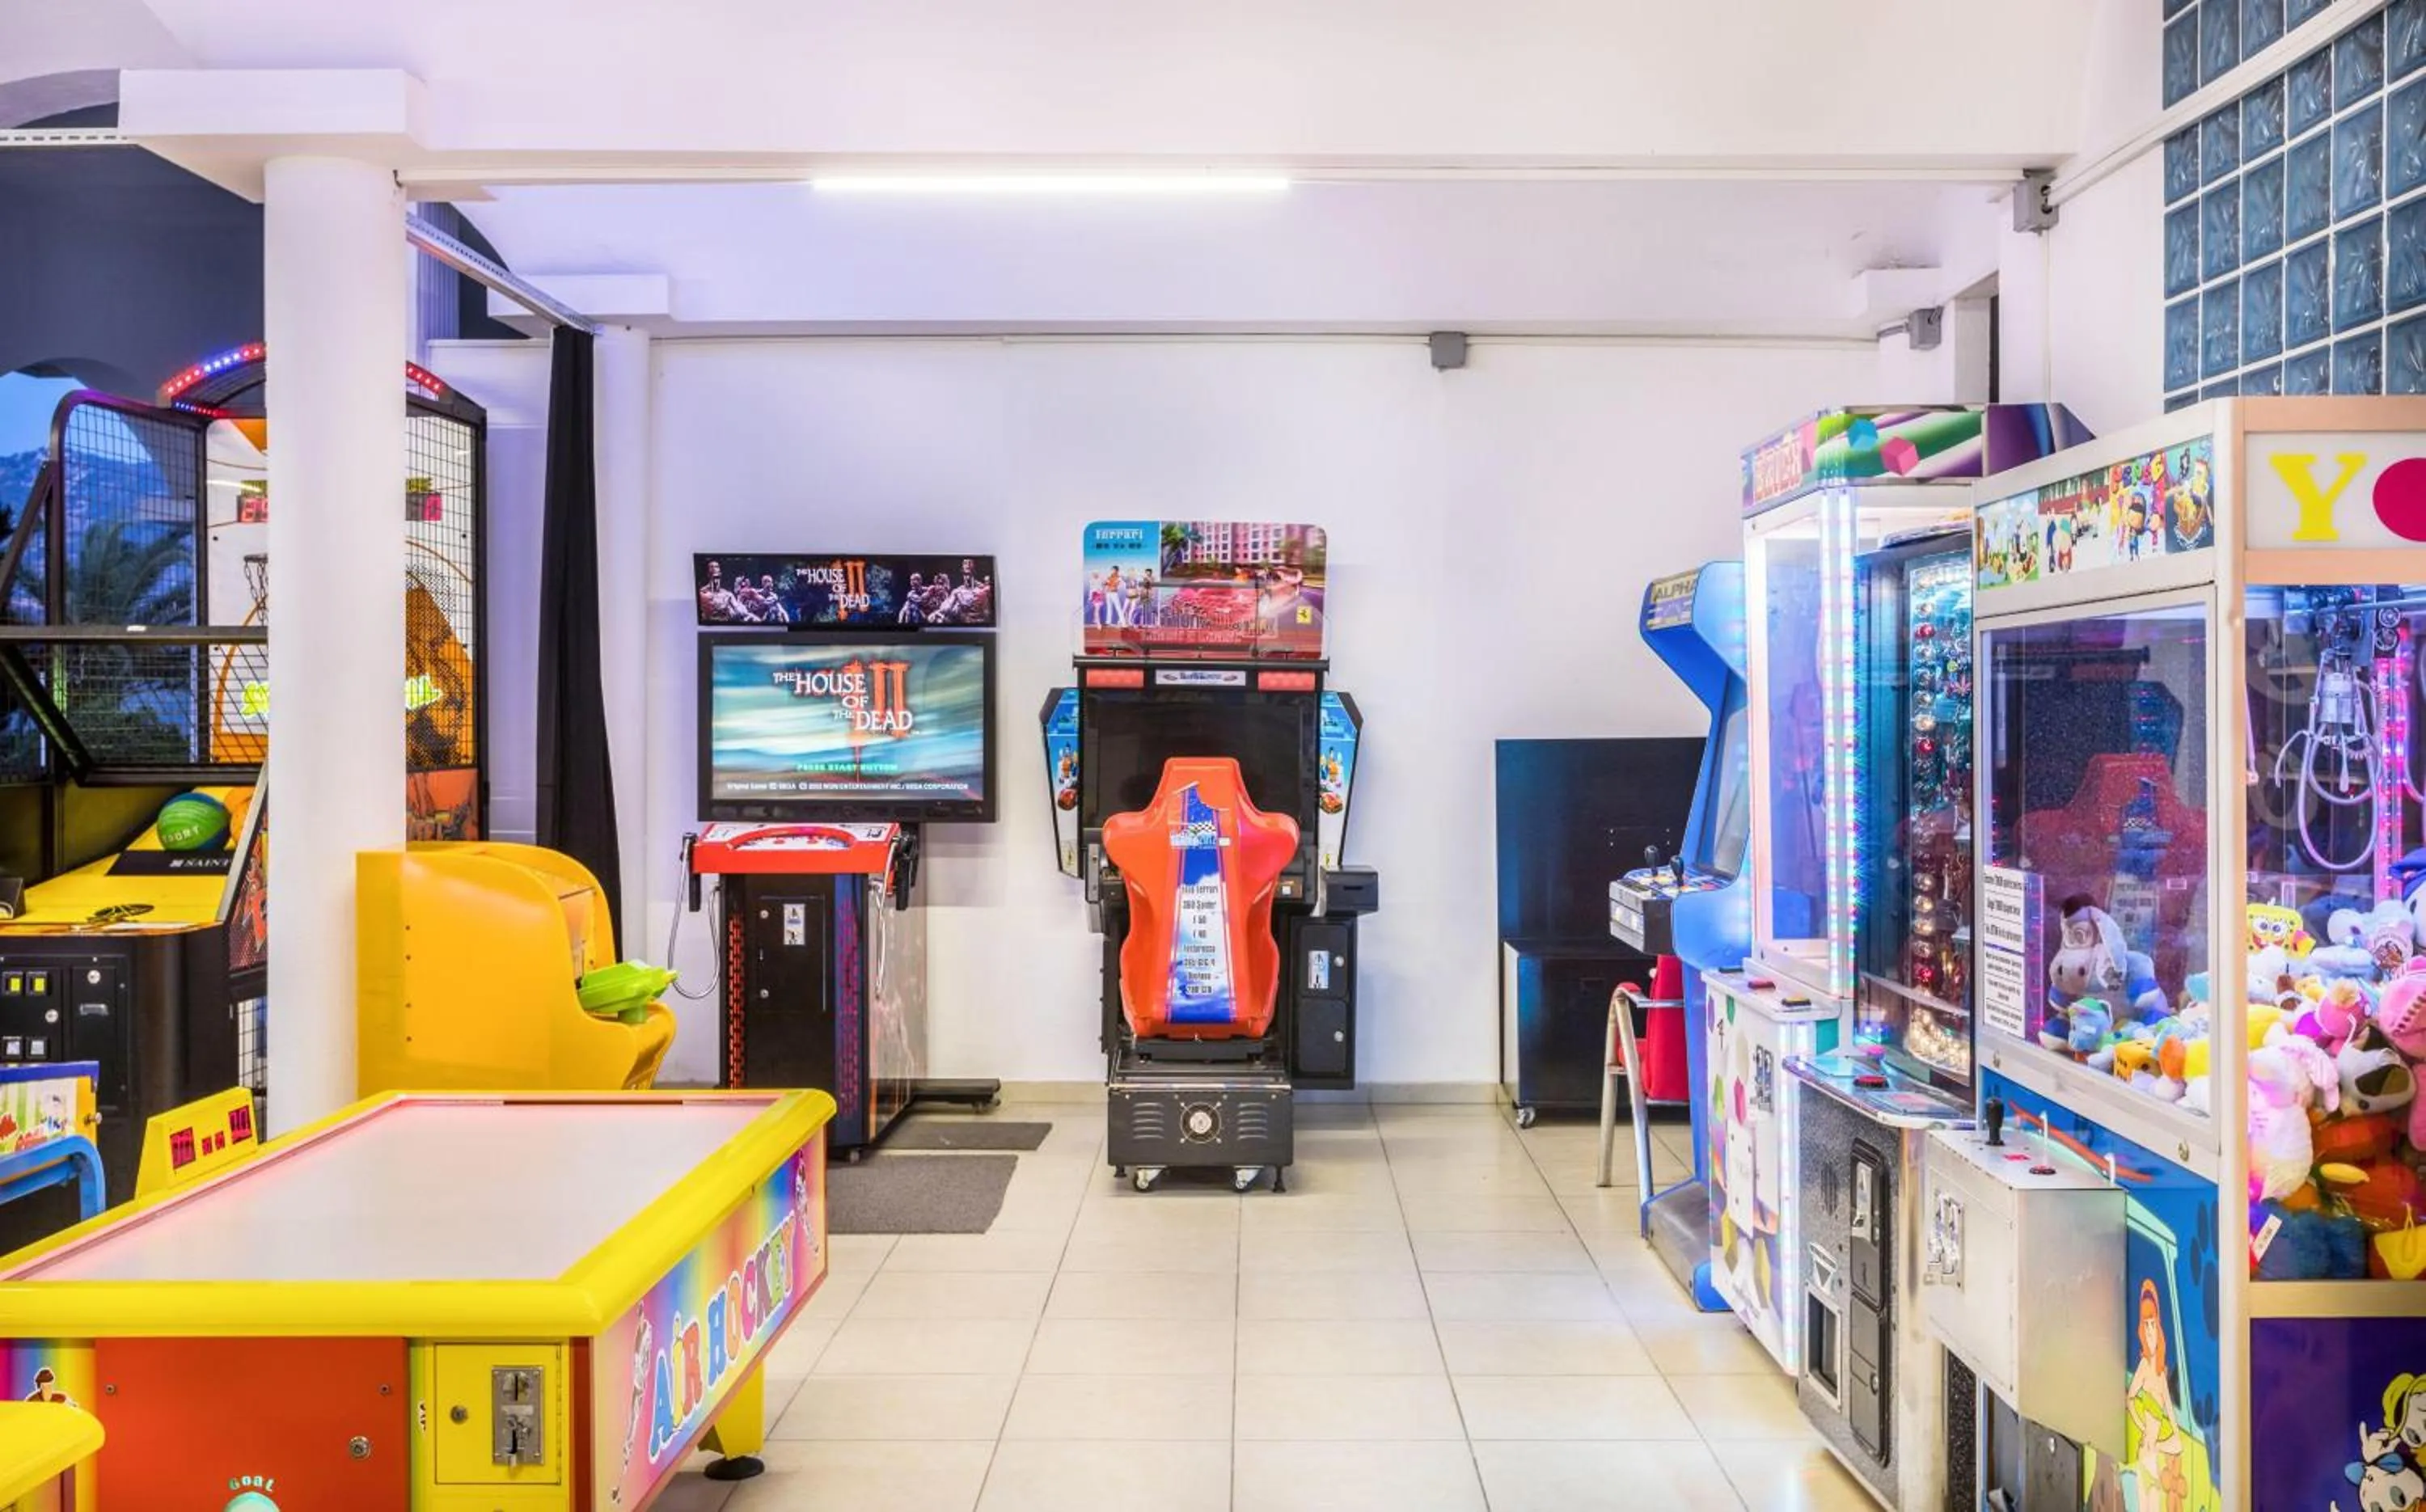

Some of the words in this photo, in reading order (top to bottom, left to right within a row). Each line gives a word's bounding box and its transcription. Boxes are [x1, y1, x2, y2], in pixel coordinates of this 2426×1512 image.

[808, 568, 845, 583] HOUSE
[832, 583, 847, 593] OF
[840, 593, 871, 608] DEAD
[772, 672, 796, 683] THE
[795, 673, 867, 695] HOUSE
[842, 695, 869, 709] OF
[833, 710, 854, 720] THE
[855, 710, 913, 731] DEAD
[705, 1210, 795, 1387] HOCKEY
